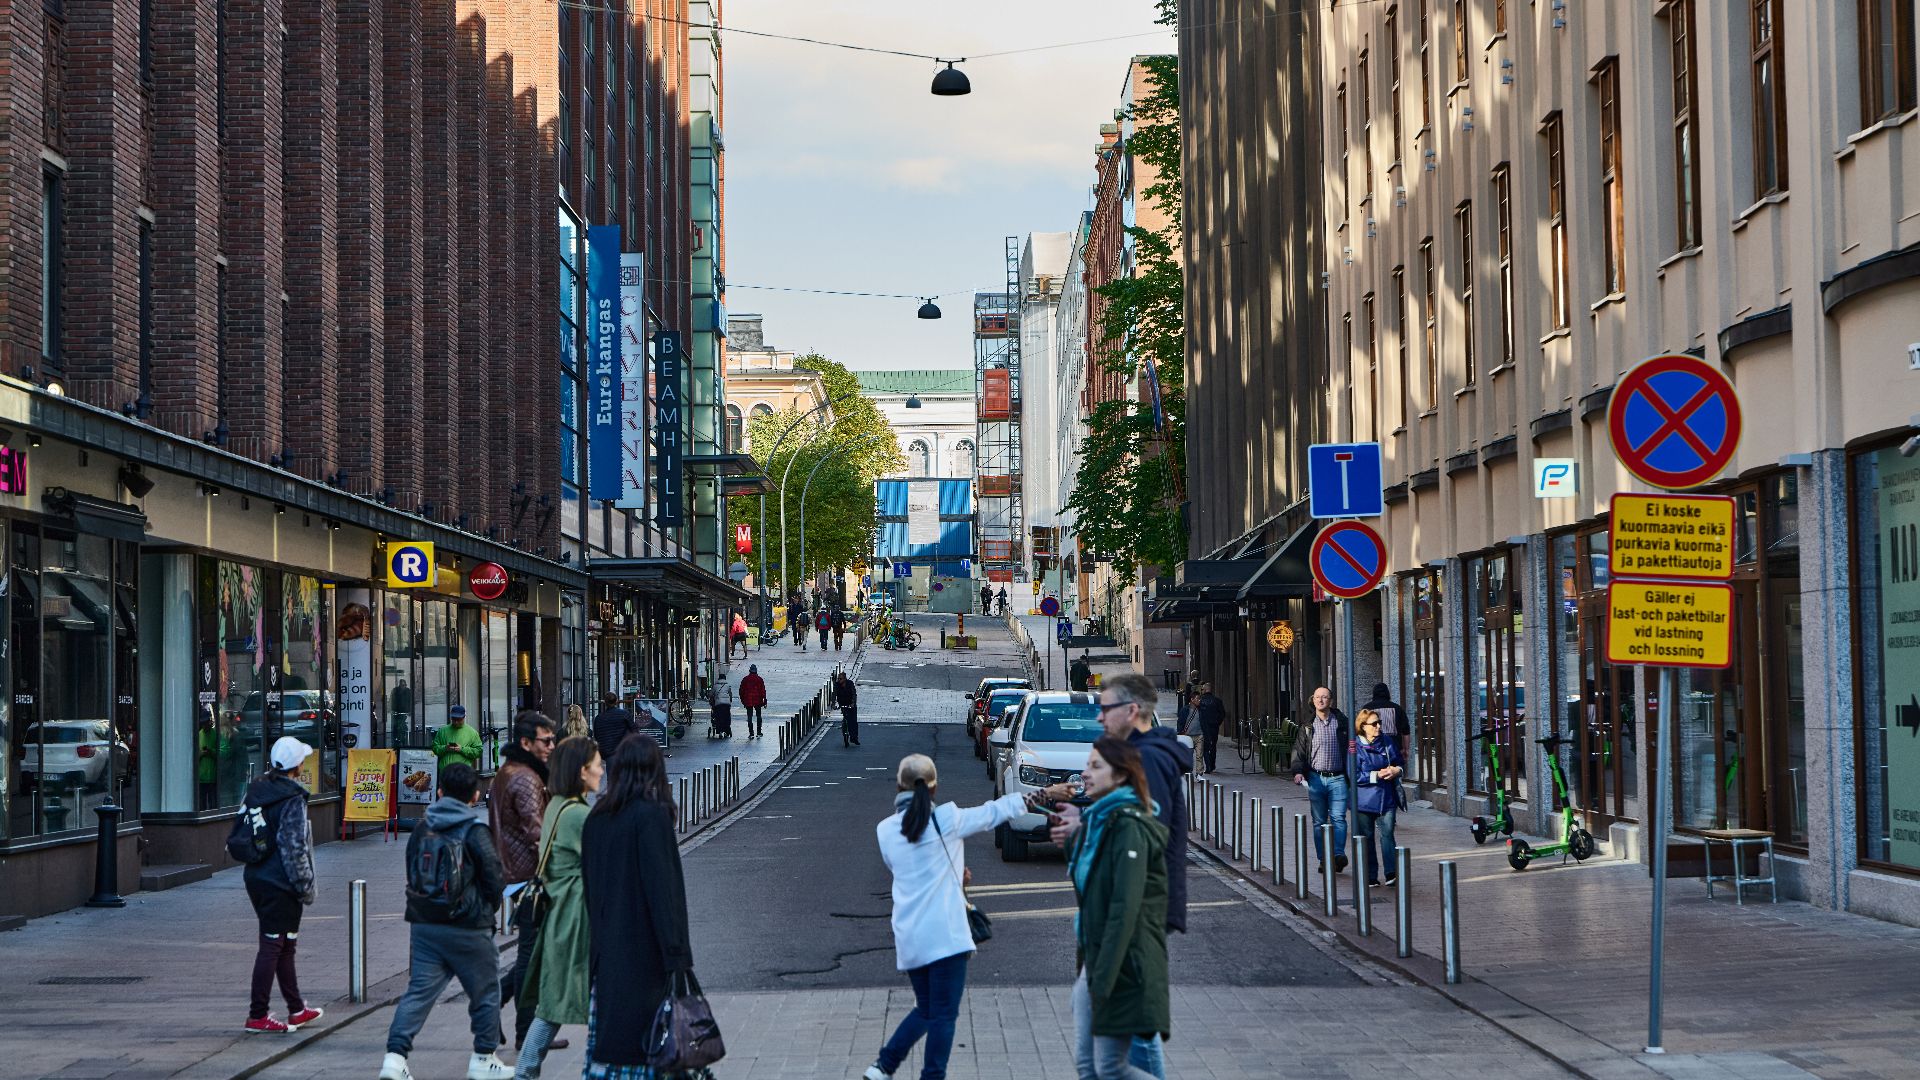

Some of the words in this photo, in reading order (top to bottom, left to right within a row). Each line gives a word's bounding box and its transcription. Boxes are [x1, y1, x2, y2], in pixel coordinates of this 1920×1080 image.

[596, 298, 615, 426] Eurokangas
[620, 295, 642, 490] CAVERNA
[660, 337, 678, 518] BEAMHILL
[1646, 503, 1659, 517] Ei
[1663, 504, 1701, 518] koske
[737, 526, 751, 541] M
[1620, 519, 1695, 535] kuormaavia
[1698, 522, 1726, 536] eikä
[1615, 537, 1671, 552] purkavia
[1674, 538, 1728, 553] kuorma-
[400, 553, 422, 577] R
[1621, 553, 1633, 568] ja
[1637, 554, 1722, 571] pakettiautoja
[471, 576, 506, 585] VEIKKAUS
[1645, 591, 1681, 604] Gäller
[1684, 592, 1695, 606] ej
[1613, 607, 1663, 621] last-och
[1666, 609, 1726, 623] paketbilar
[1634, 625, 1652, 638] vid
[1655, 626, 1703, 641] lastning
[1629, 643, 1651, 655] och
[1654, 643, 1704, 659] lossning
[351, 667, 362, 680] ja
[352, 685, 367, 694] on
